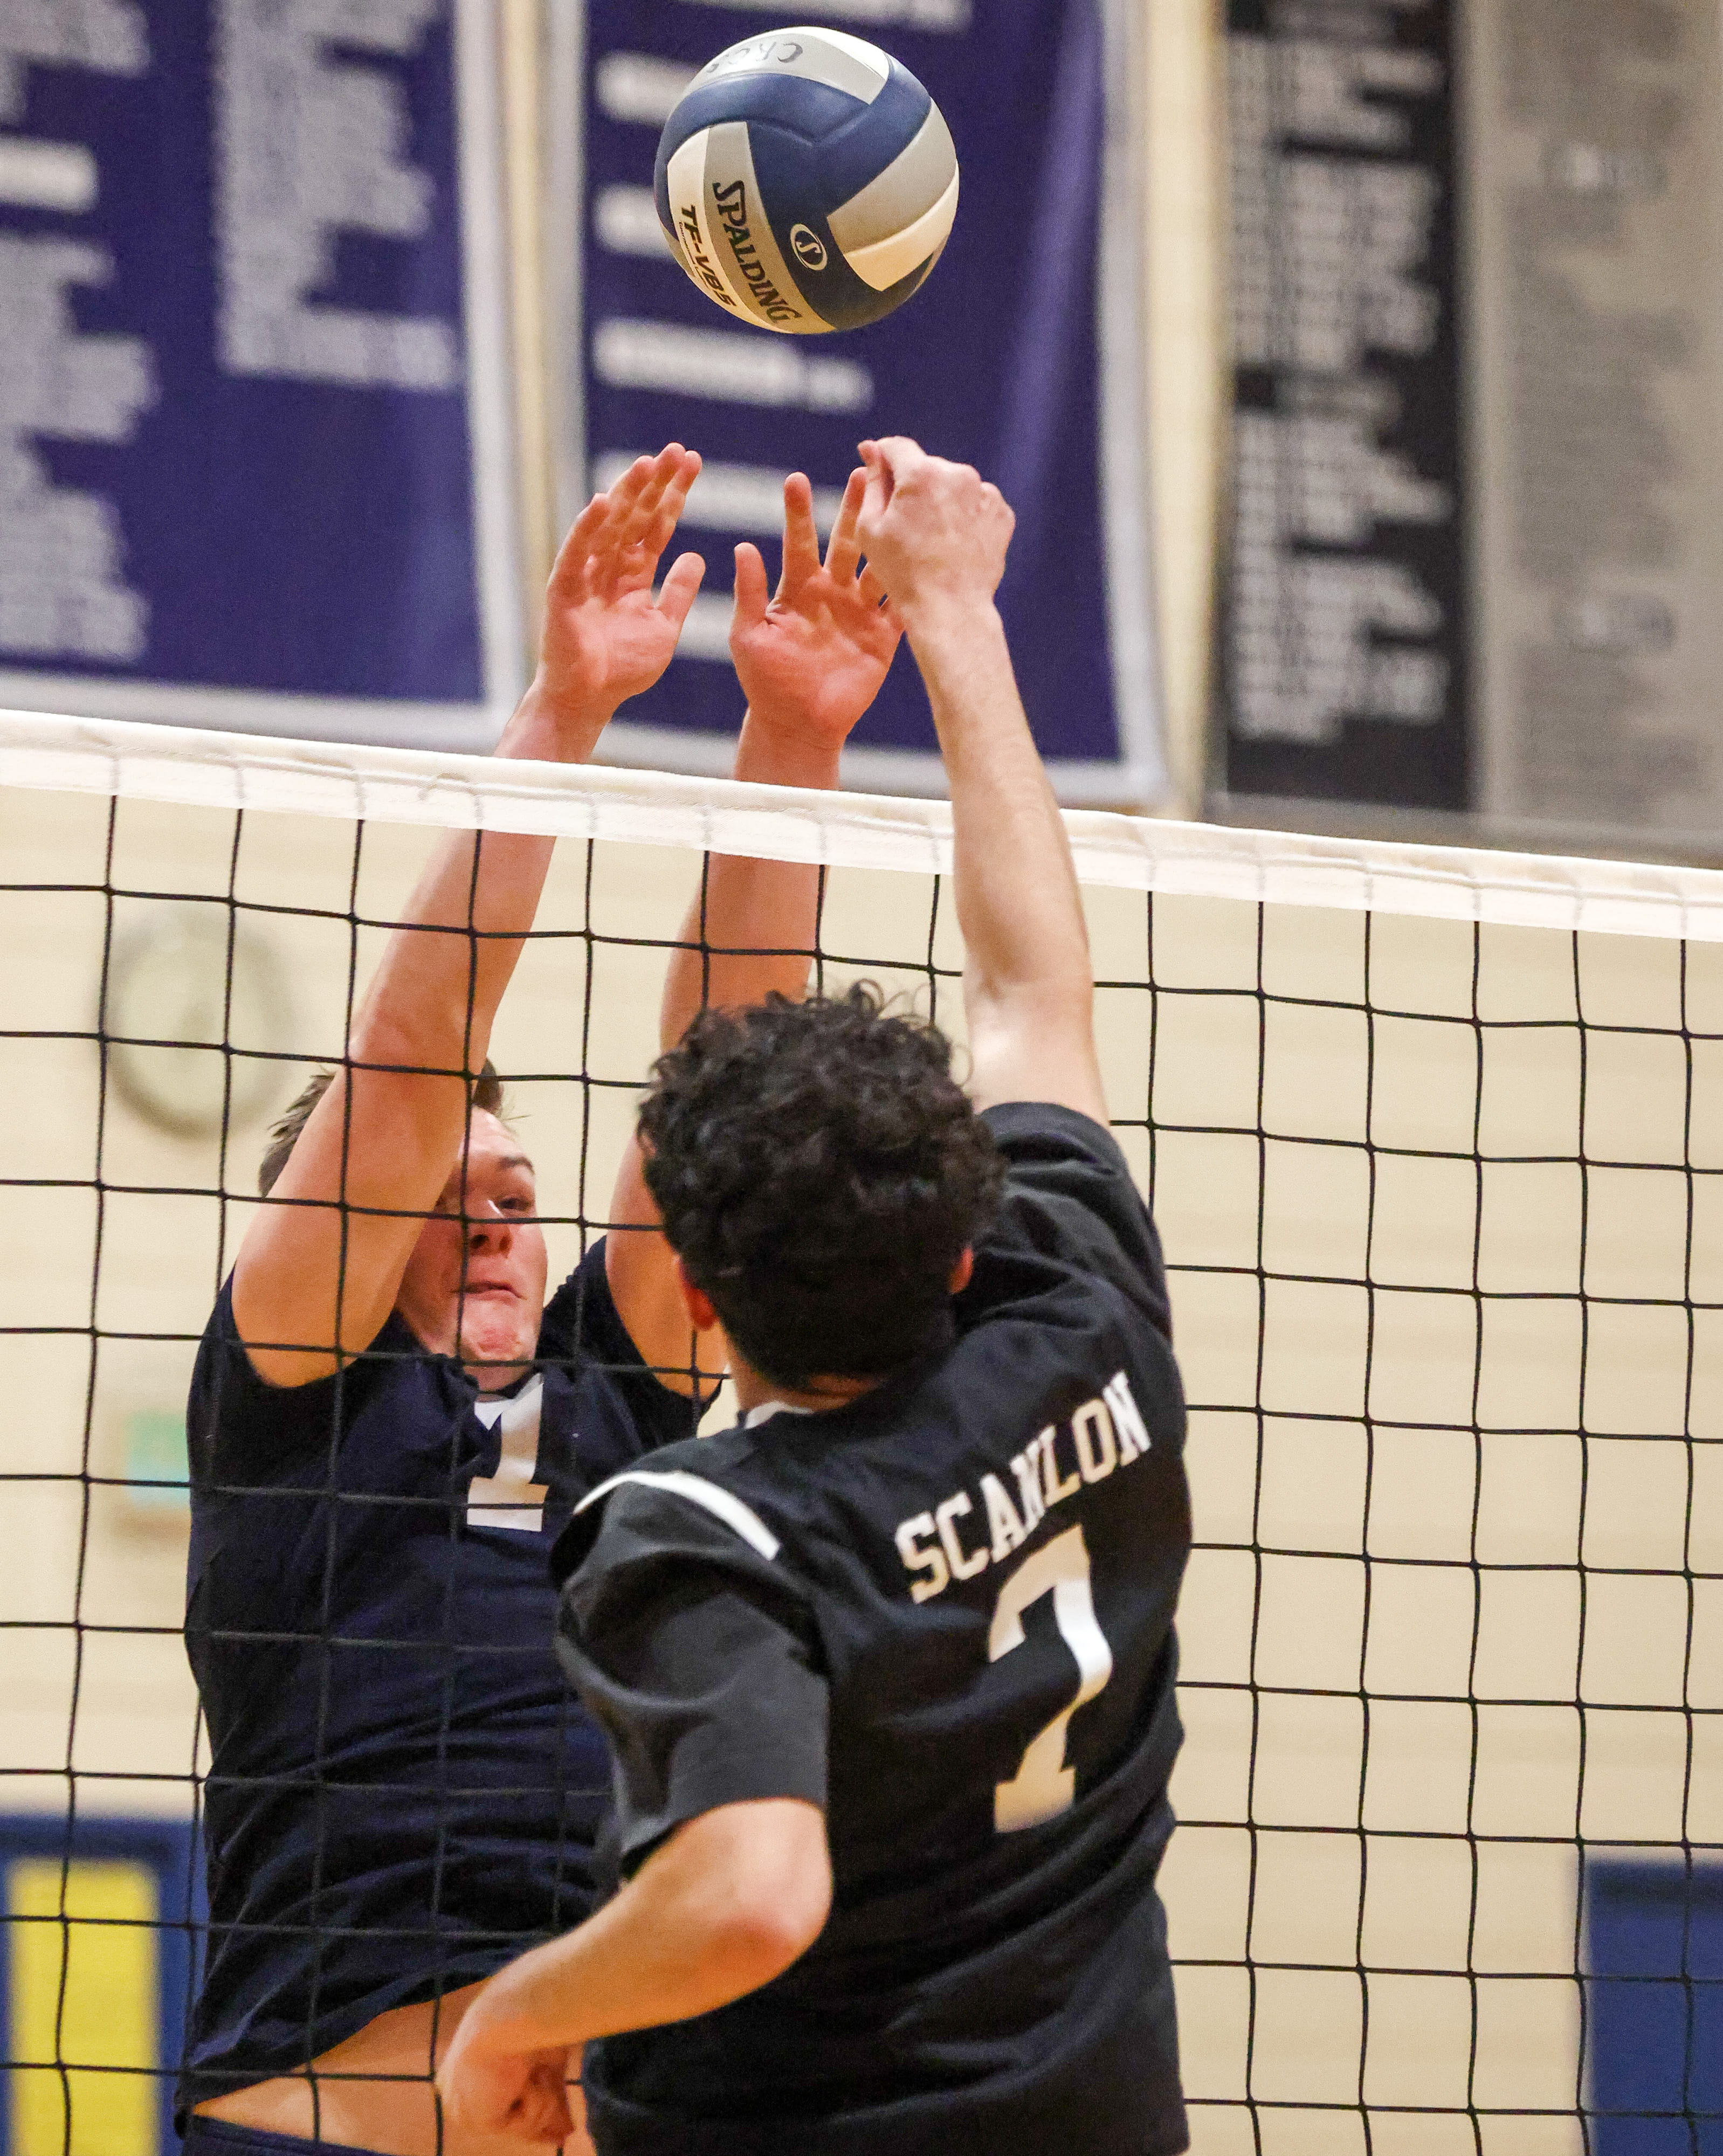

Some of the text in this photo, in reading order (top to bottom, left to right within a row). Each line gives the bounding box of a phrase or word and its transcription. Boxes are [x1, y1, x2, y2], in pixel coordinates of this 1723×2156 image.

[681, 204, 737, 307] TF-VB5
[712, 179, 803, 323] SPALDING
[466, 1372, 550, 1532] 1
[894, 1370, 1152, 1604] SCANLON
[988, 1523, 1114, 1834] 7
